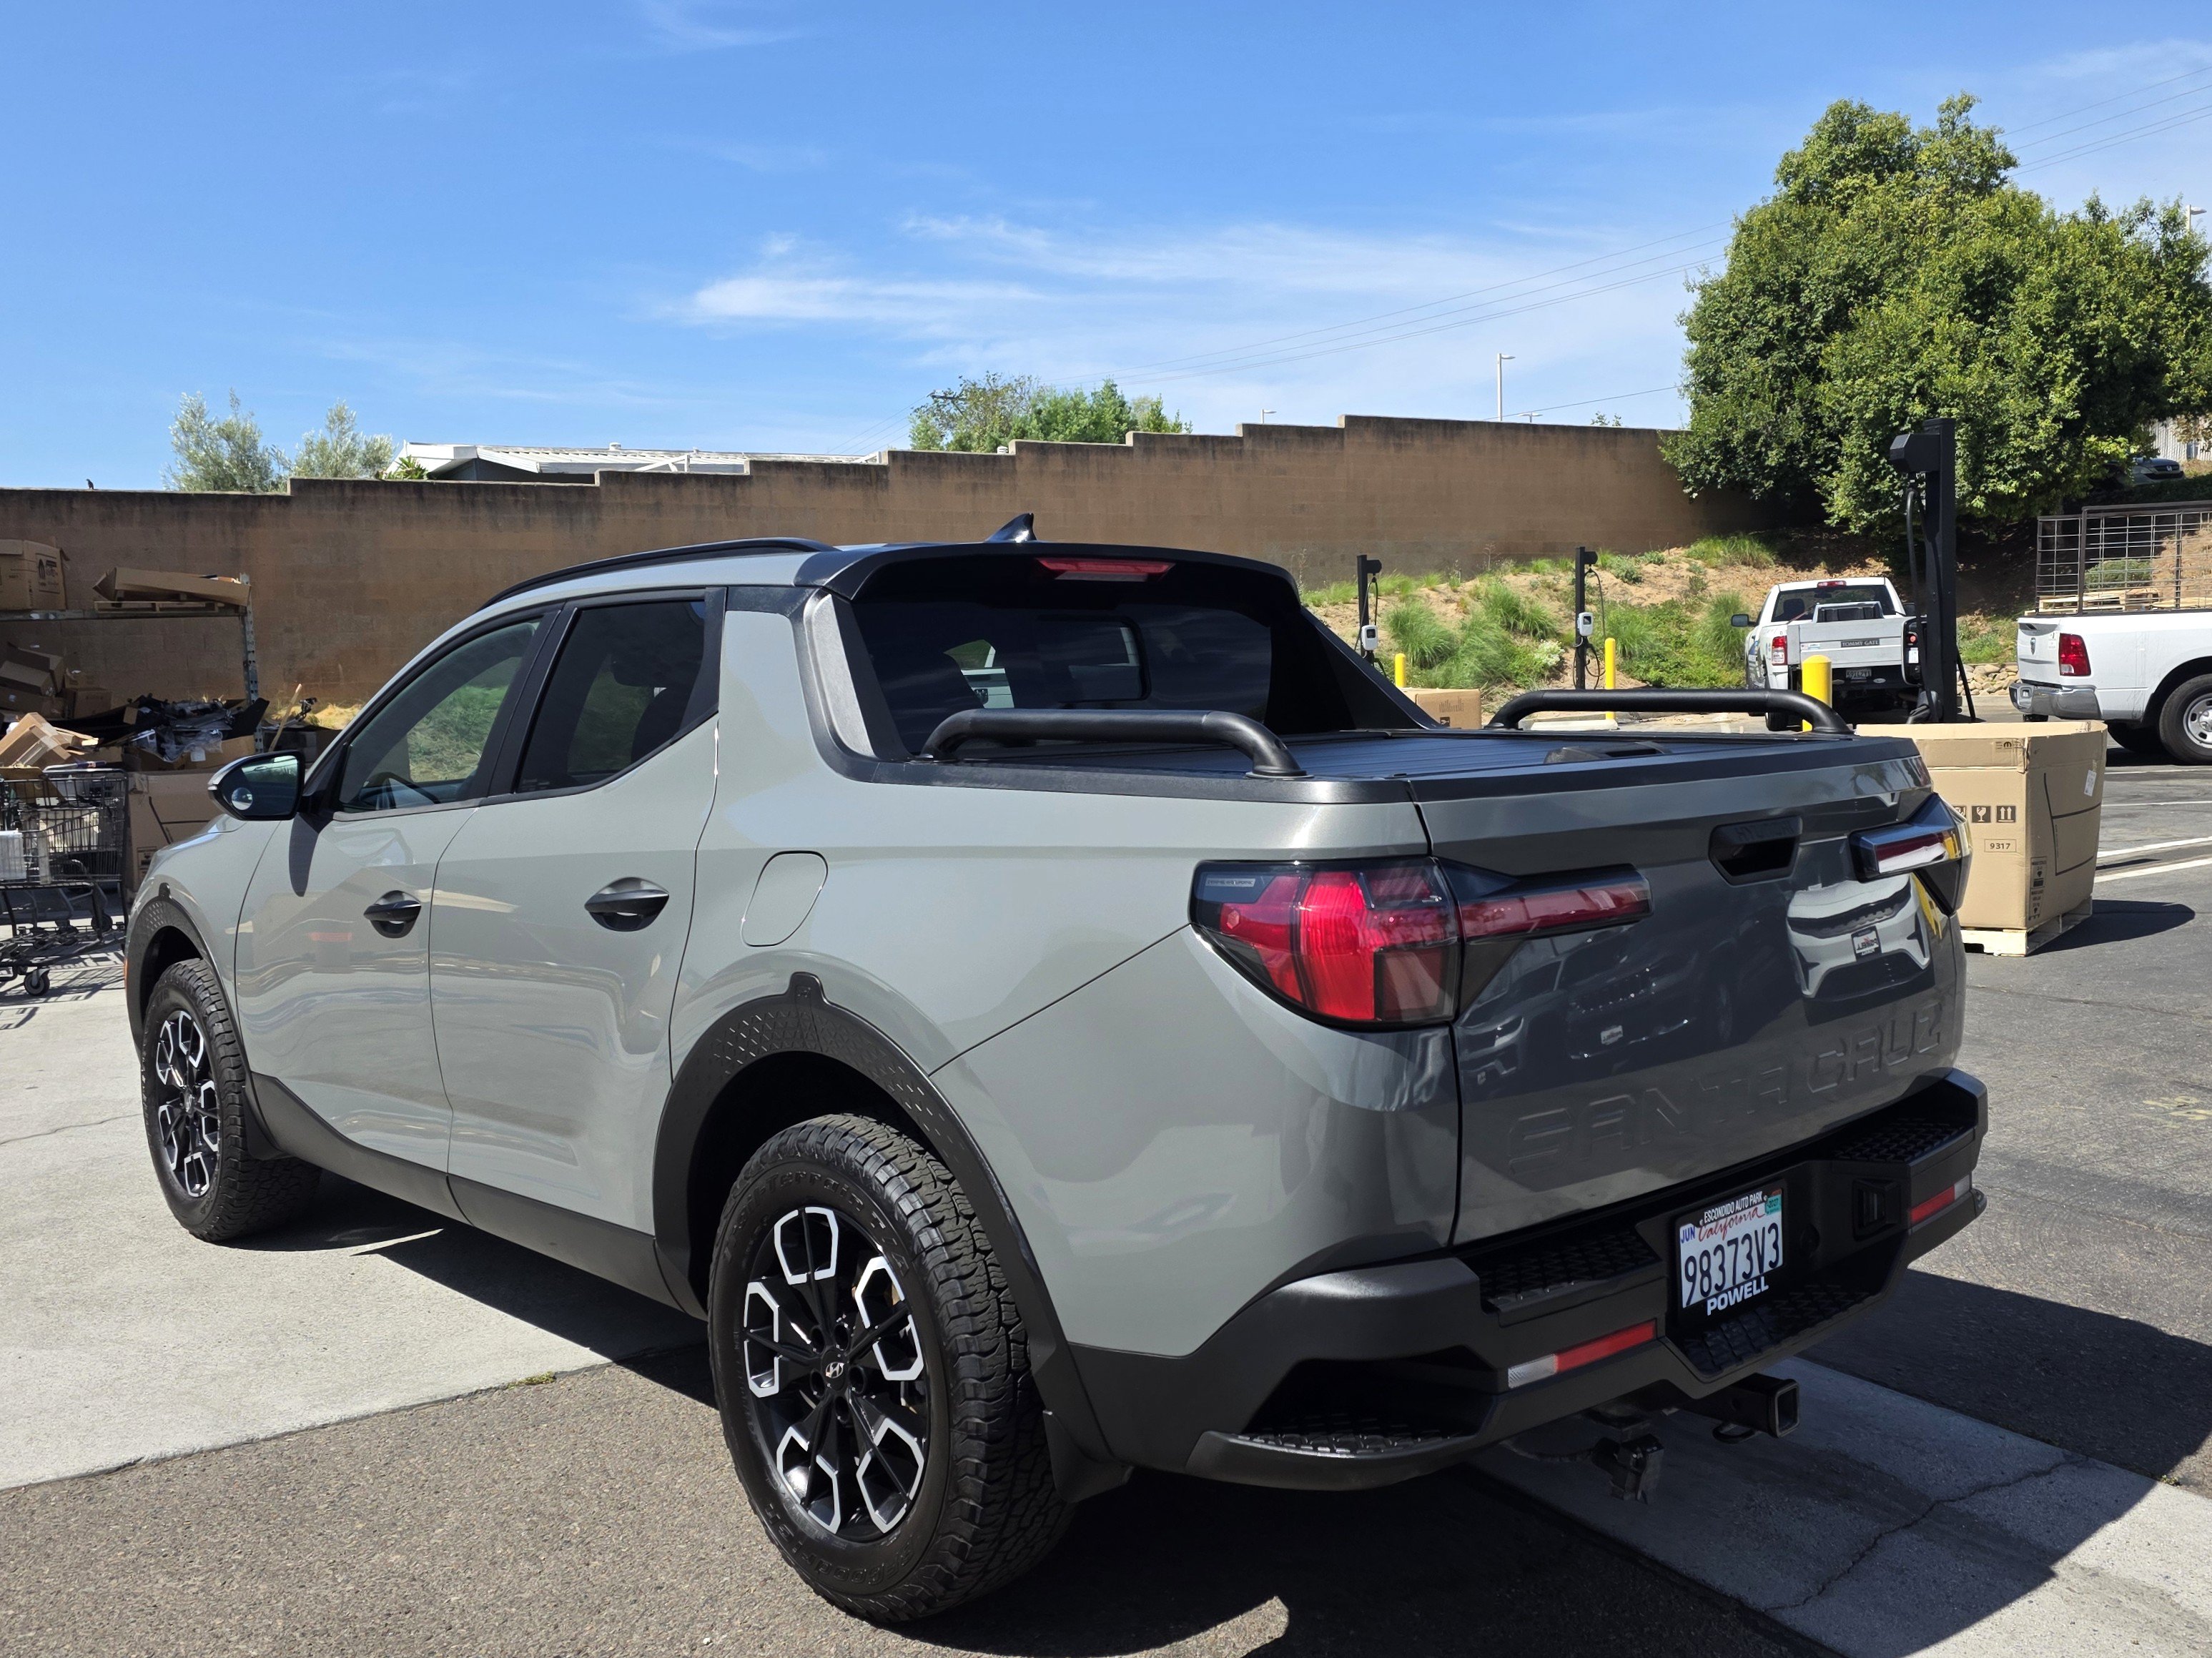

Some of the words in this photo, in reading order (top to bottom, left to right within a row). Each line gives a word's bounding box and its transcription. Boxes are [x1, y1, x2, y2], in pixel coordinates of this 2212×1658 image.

[1507, 1062, 1794, 1176] SANTA
[1807, 1000, 1942, 1095] CRUZ
[1698, 1206, 1766, 1242] California
[1704, 1202, 1734, 1224] ESCONDIDO
[1735, 1196, 1749, 1212] AUTO
[1749, 1191, 1764, 1207] PARK
[1681, 1225, 1696, 1243] JUN
[1684, 1223, 1779, 1307] 98373V3
[1707, 1276, 1769, 1316] POWELL
